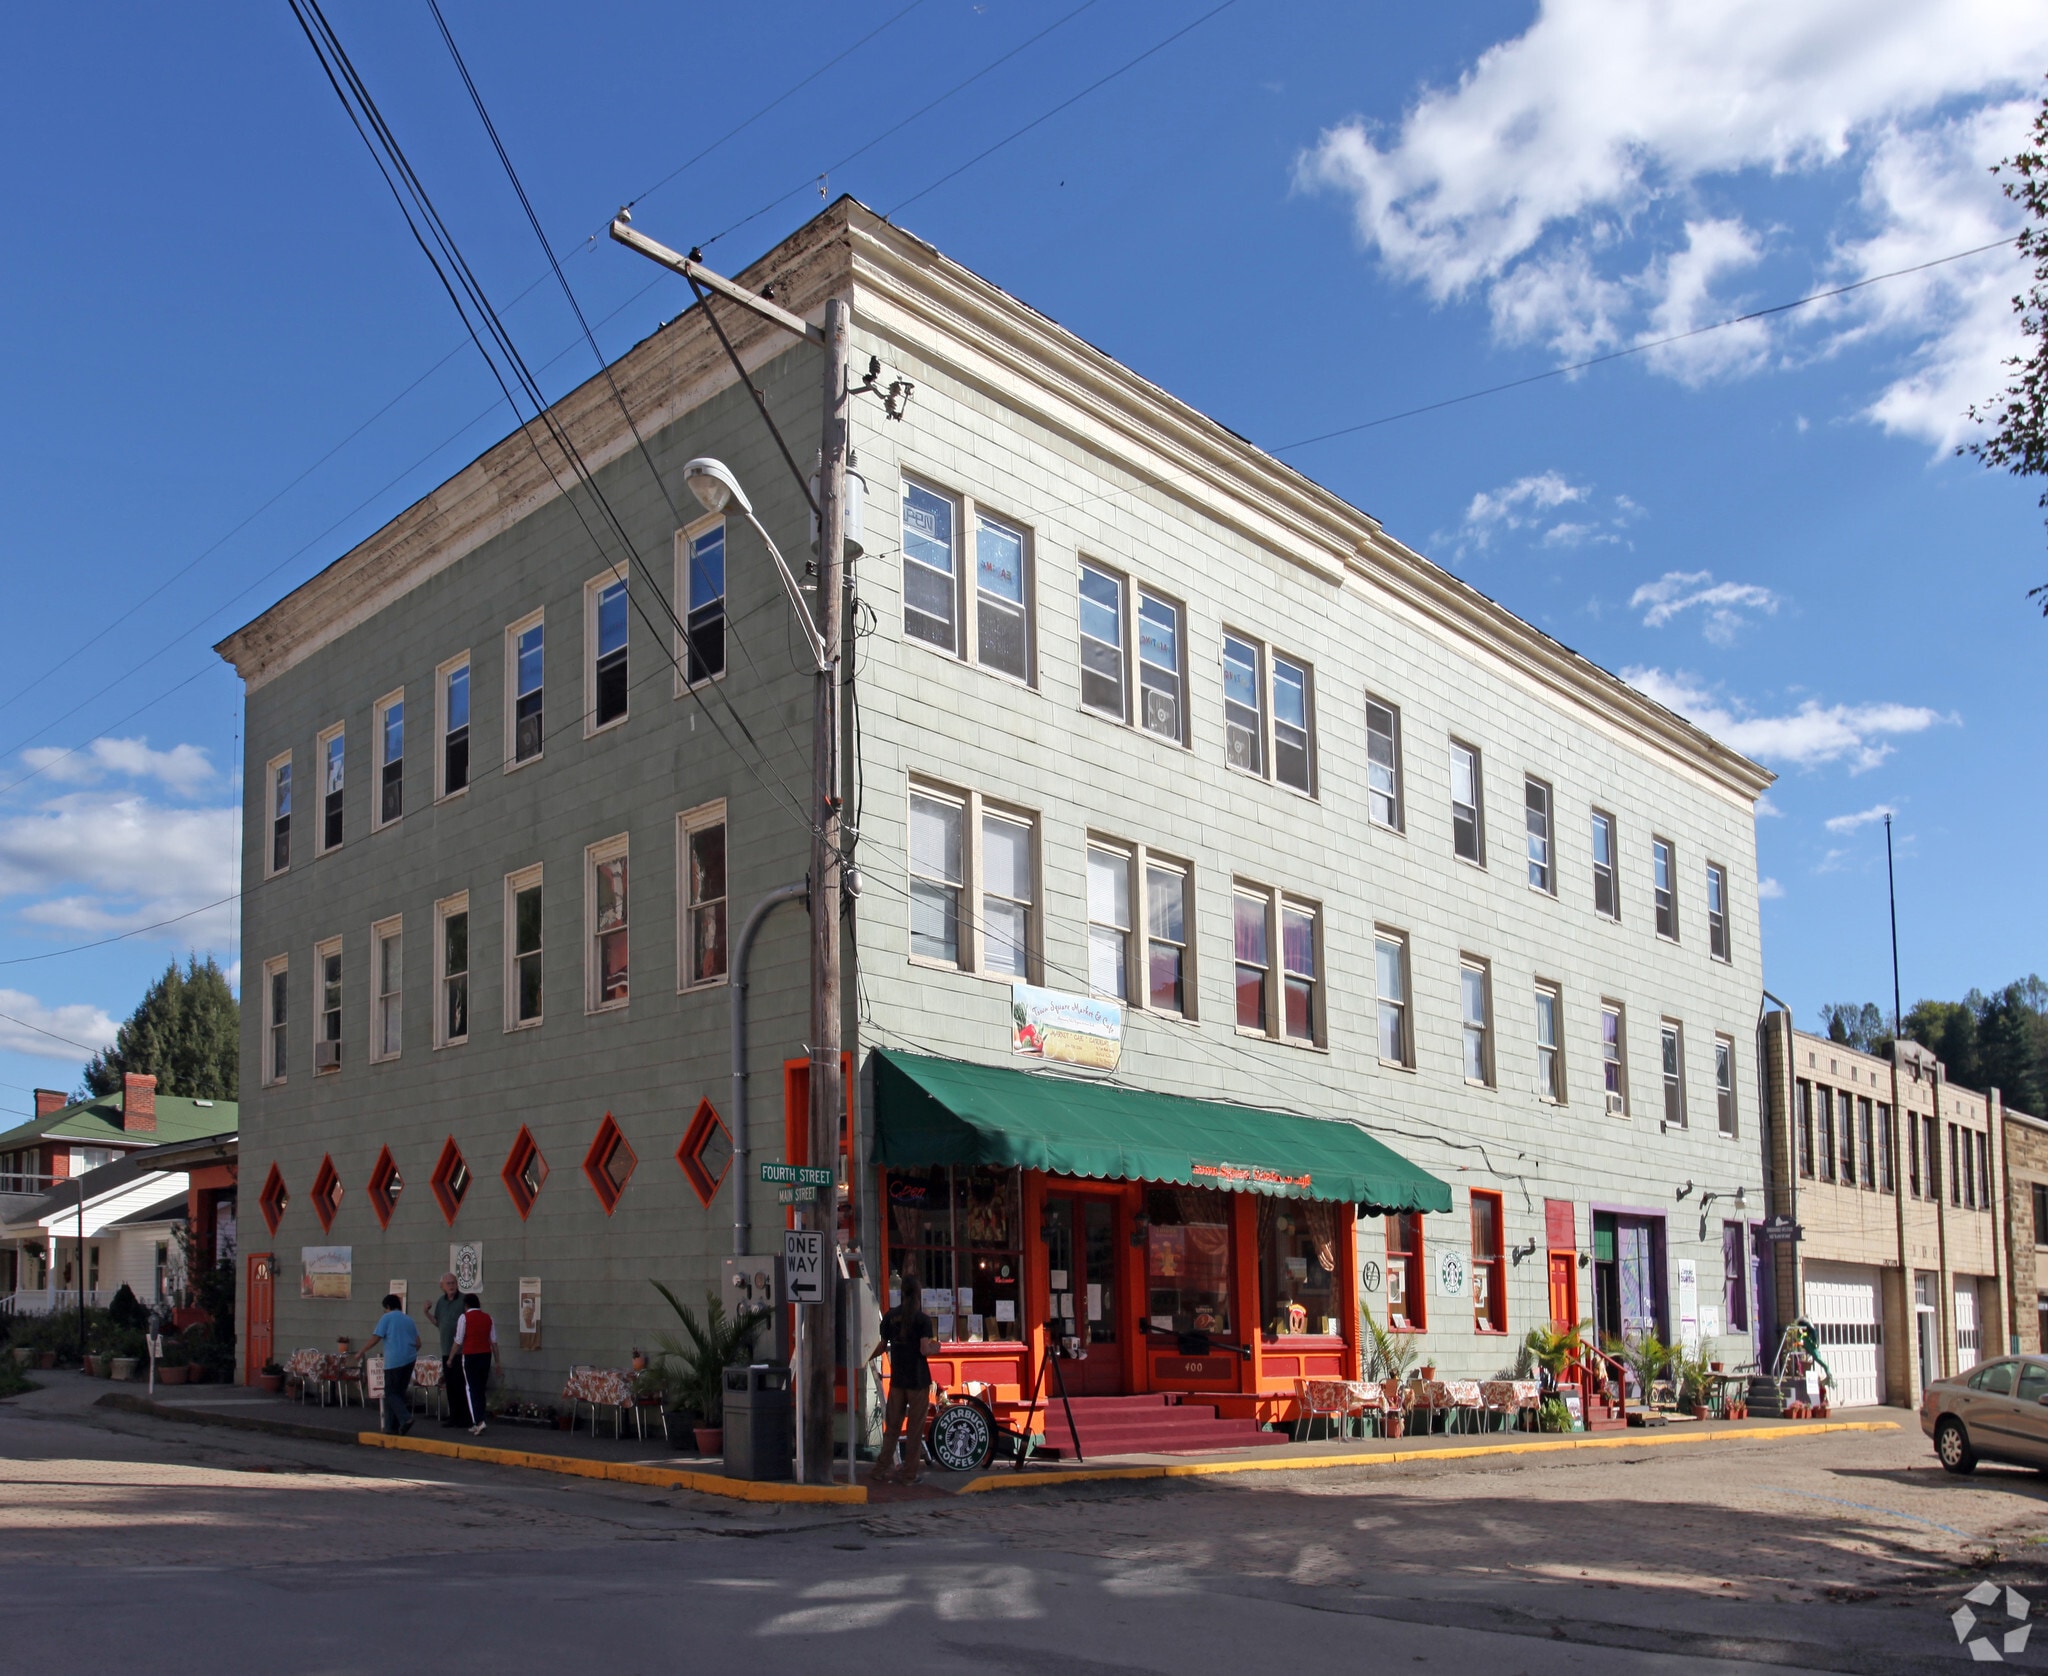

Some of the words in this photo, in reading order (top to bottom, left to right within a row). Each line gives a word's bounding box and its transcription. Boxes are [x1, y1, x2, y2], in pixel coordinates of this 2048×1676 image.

[1032, 1006, 1049, 1017] Town
[1050, 1000, 1070, 1015] Square
[1071, 1002, 1094, 1018] Market
[1094, 1011, 1102, 1022] &
[762, 1165, 796, 1181] FOURTH
[799, 1168, 831, 1184] STREET
[779, 1188, 793, 1202] MAIN
[795, 1186, 817, 1202] STREET
[788, 1237, 817, 1254] ONE
[787, 1257, 818, 1273] WAY
[1185, 1362, 1203, 1372] 400
[940, 1408, 987, 1442] STARBUCKS
[939, 1445, 975, 1467] COFFEE
